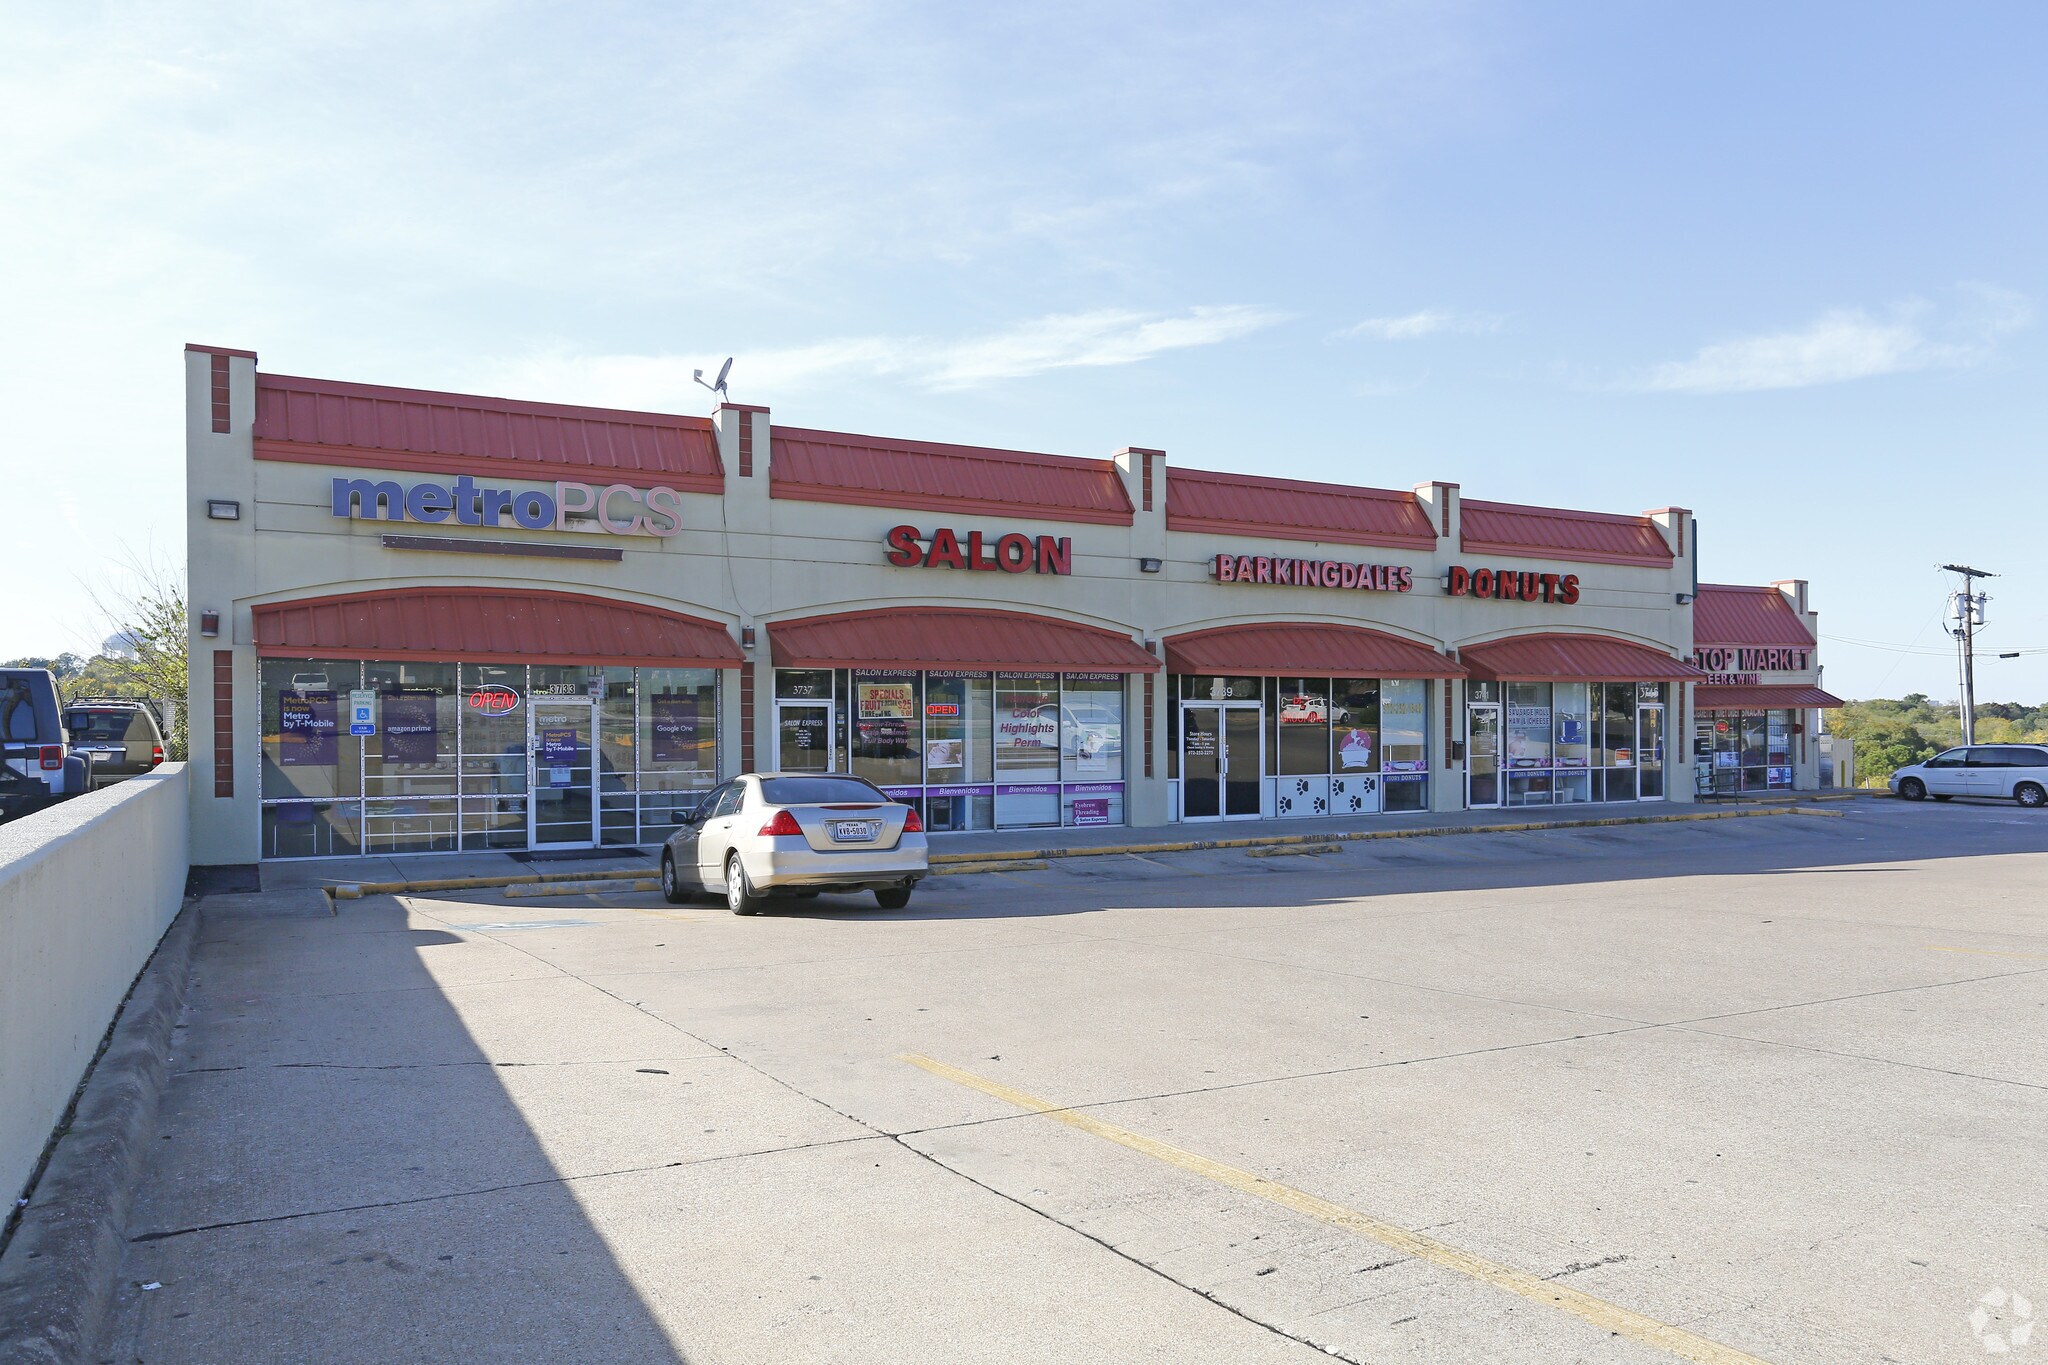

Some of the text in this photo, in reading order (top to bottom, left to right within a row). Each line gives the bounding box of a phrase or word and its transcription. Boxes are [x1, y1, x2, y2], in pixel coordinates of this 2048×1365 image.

[332, 475, 683, 537] metroPCS
[887, 525, 1071, 575] SALON
[1216, 554, 1413, 592] BARKINGDALES
[1448, 565, 1580, 605] DONUTS
[1740, 648, 1812, 671] MARKET
[1704, 674, 1728, 685] EER
[1737, 673, 1762, 685] WINE
[550, 684, 575, 694] 3733
[793, 685, 813, 694] 3737
[870, 689, 904, 700] SPECIALS
[283, 696, 328, 704] MetroPCS
[469, 692, 516, 708] OPEN
[860, 700, 881, 711] FRUIT
[897, 700, 912, 710] $25
[926, 705, 957, 715] OPEN
[1012, 708, 1040, 718] Color
[1508, 708, 1533, 716] SAUSAGE
[1741, 709, 1766, 717] SNACKS
[283, 720, 294, 728] by
[784, 719, 823, 727] SALON EXPRESS
[656, 725, 679, 733] Google
[1000, 722, 1055, 735] Highlights
[877, 737, 894, 745] Body
[1014, 737, 1041, 747] Perm
[939, 787, 980, 795] Bienvenidos
